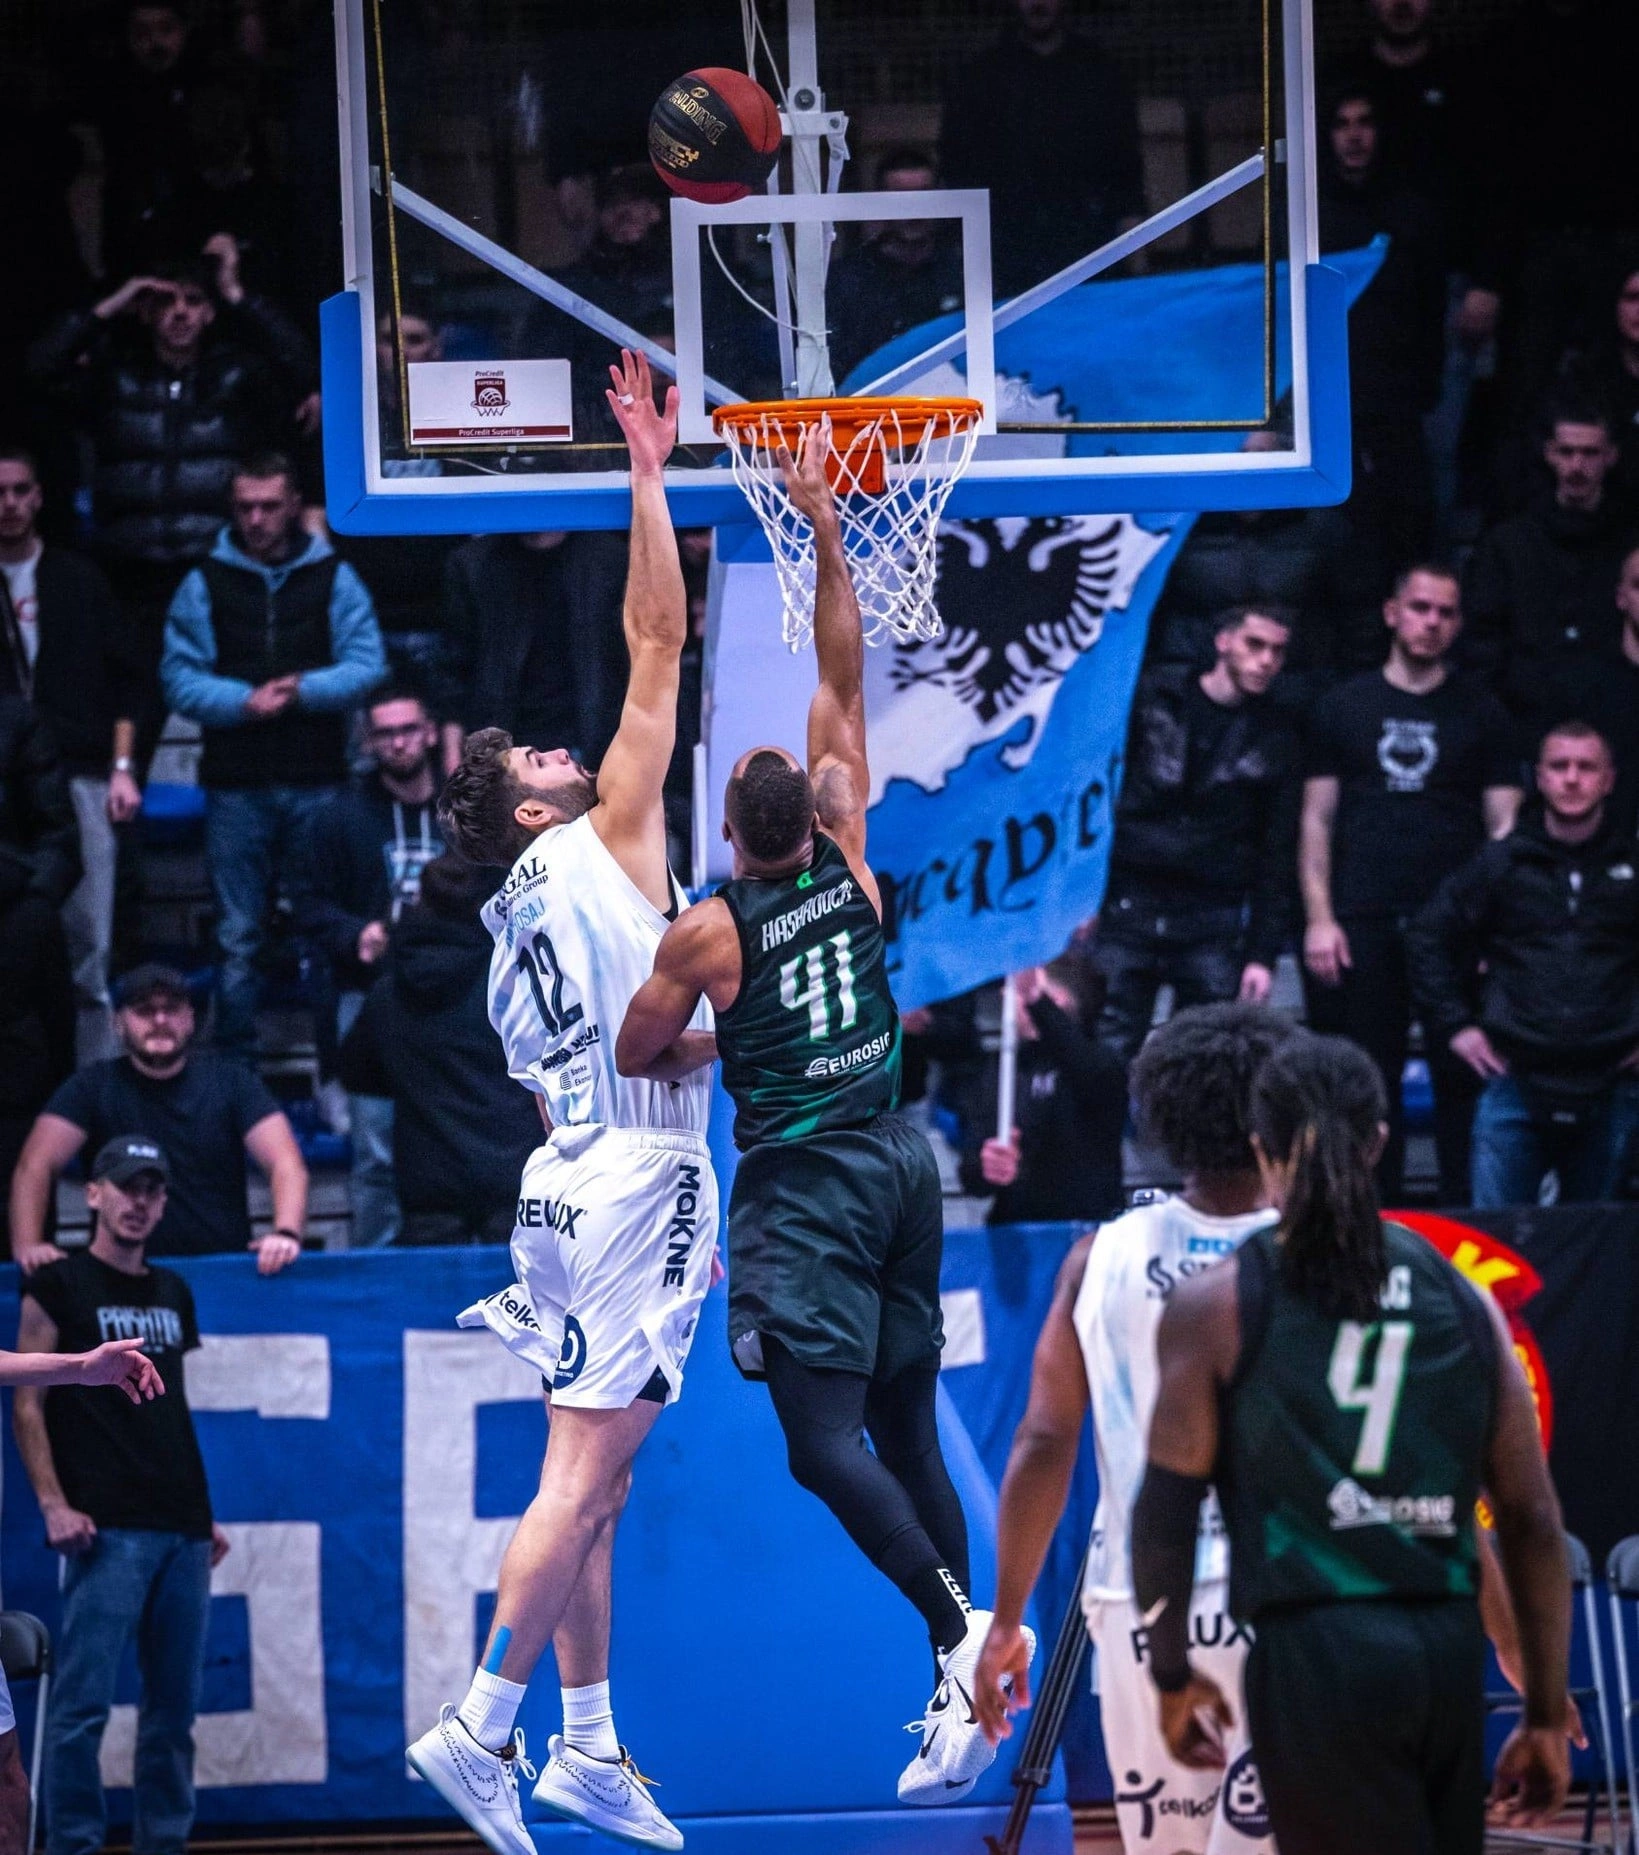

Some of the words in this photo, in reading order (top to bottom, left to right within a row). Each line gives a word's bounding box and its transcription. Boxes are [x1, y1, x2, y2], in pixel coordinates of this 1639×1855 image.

[668, 86, 728, 146] ALDING
[491, 428, 525, 437] Superliga
[501, 856, 547, 895] GAL
[522, 874, 549, 894] Group
[516, 931, 585, 1038] 12
[779, 929, 858, 1042] 41
[661, 1163, 701, 1289] MOKNE
[1327, 1320, 1415, 1477] 4
[1130, 1612, 1256, 1662] RUX
